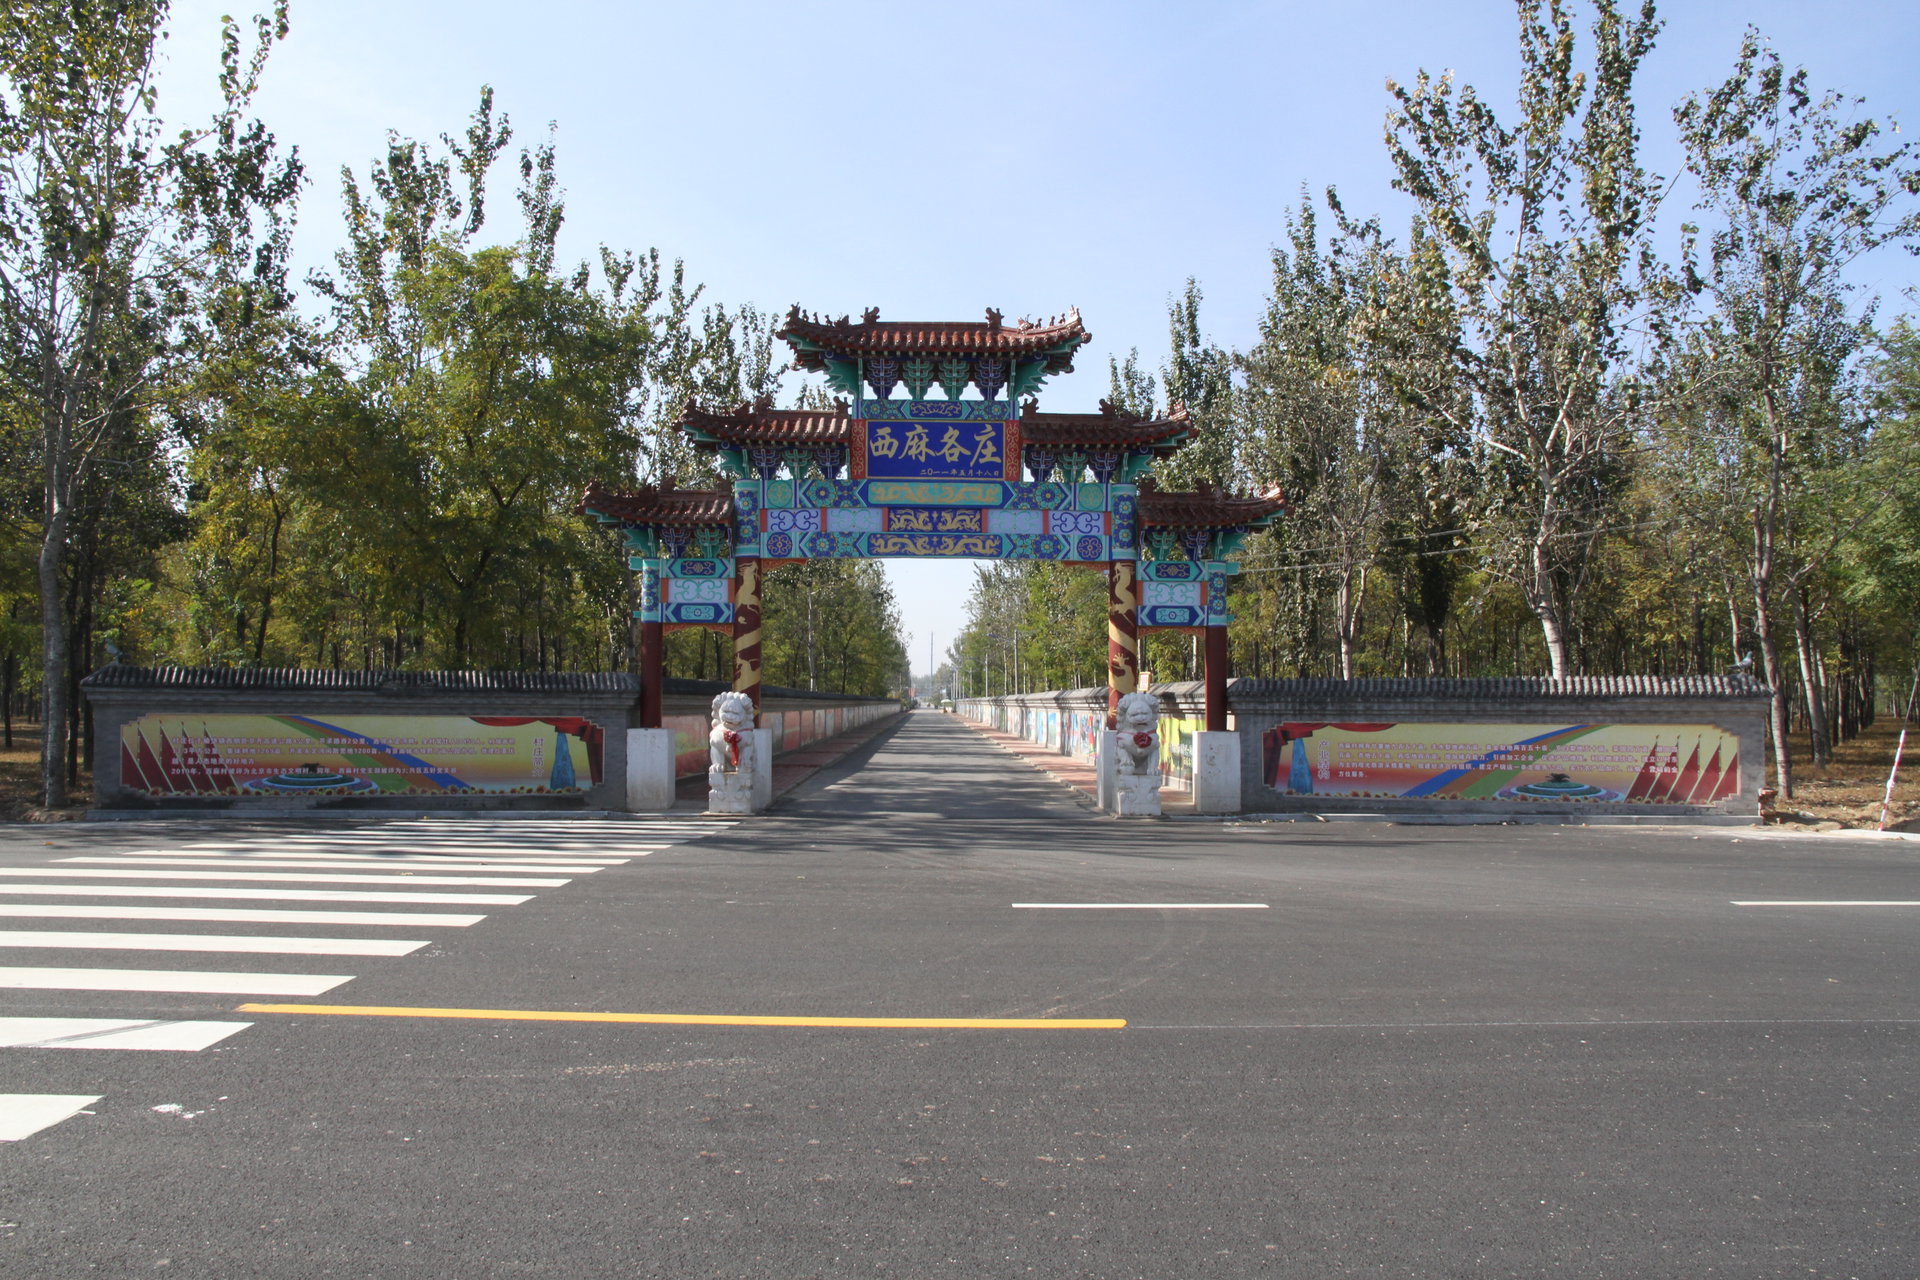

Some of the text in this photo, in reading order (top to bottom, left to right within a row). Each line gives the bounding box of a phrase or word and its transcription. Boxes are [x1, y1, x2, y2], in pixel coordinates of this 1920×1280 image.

[870, 424, 1002, 467] 西麻各庄
[532, 737, 545, 777] 村庄简介
[1318, 740, 1330, 780] 产业结构
